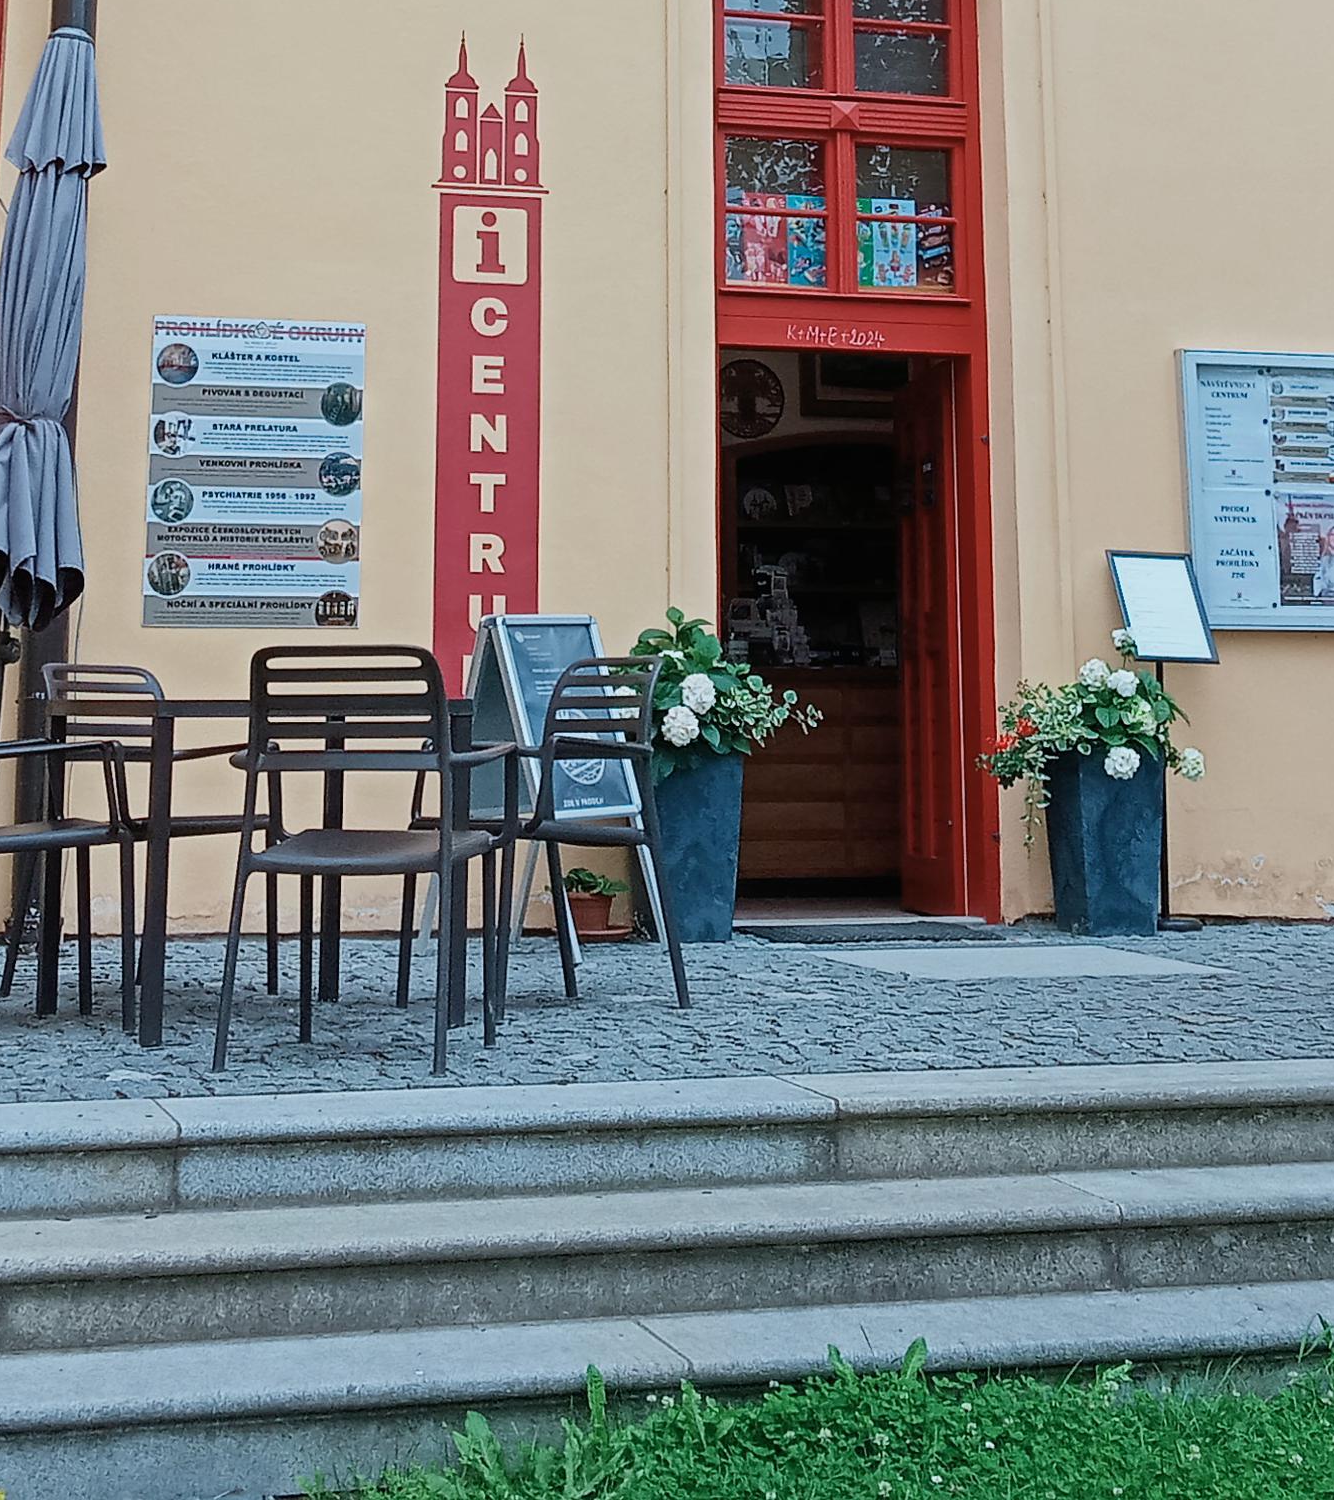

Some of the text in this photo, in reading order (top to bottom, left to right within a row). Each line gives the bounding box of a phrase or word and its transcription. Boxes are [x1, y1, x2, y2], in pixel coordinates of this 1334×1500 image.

[154, 320, 285, 341] PROHLÍDKOÉ
[212, 351, 301, 363] KLÁŠTER A KOSTEL
[202, 388, 242, 397] PIVOVAR
[252, 389, 305, 399] DEGUSTACÍ
[1211, 391, 1248, 399] CENTRUM
[245, 424, 298, 433] PRELATURA
[199, 459, 303, 469] VENKOVNÍ PROHLÍDKA
[202, 491, 262, 500] PSYCHIATRIE
[294, 492, 316, 501] 1992
[461, 298, 509, 696] CENTRU
[1220, 505, 1250, 513] PRODEJ
[168, 525, 302, 535] EXPOZICE ČESKOSLOVENSKÝCH
[212, 535, 218, 543] A
[220, 535, 260, 543] HISTORIE
[208, 562, 297, 572] HRANÉ PROHLÍDKY
[167, 599, 198, 609] NOČNÍ
[209, 600, 258, 609] SPECIÁLNÍ
[260, 601, 314, 610] PROHLÍDKY
